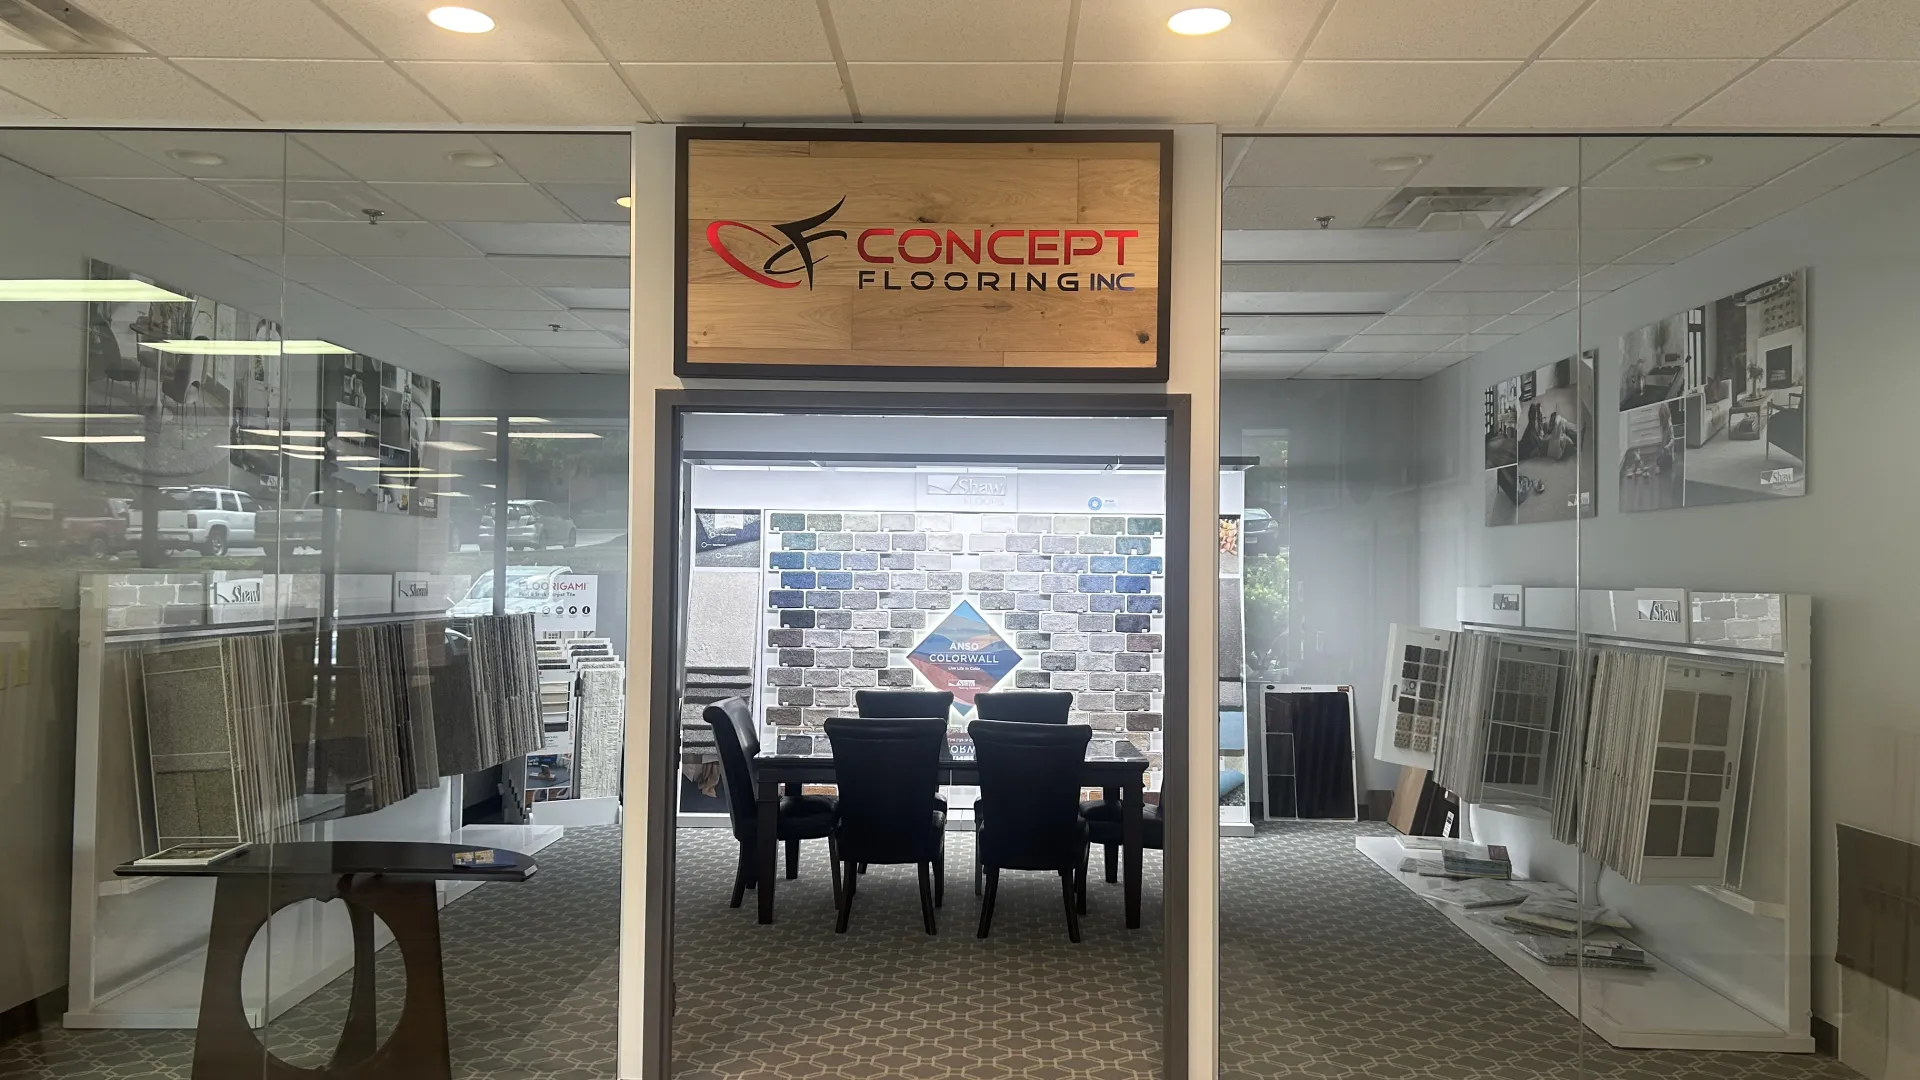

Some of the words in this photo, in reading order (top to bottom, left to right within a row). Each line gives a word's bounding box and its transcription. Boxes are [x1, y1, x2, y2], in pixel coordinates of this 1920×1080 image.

[857, 228, 1139, 265] CONCEPT
[857, 271, 1079, 291] FLOORING
[1090, 272, 1136, 292] INC
[958, 478, 1004, 494] Shaw
[232, 585, 260, 603] Shaw
[1653, 603, 1679, 622] Shaw
[949, 642, 980, 651] ANSO
[929, 653, 999, 663] COLORWALL
